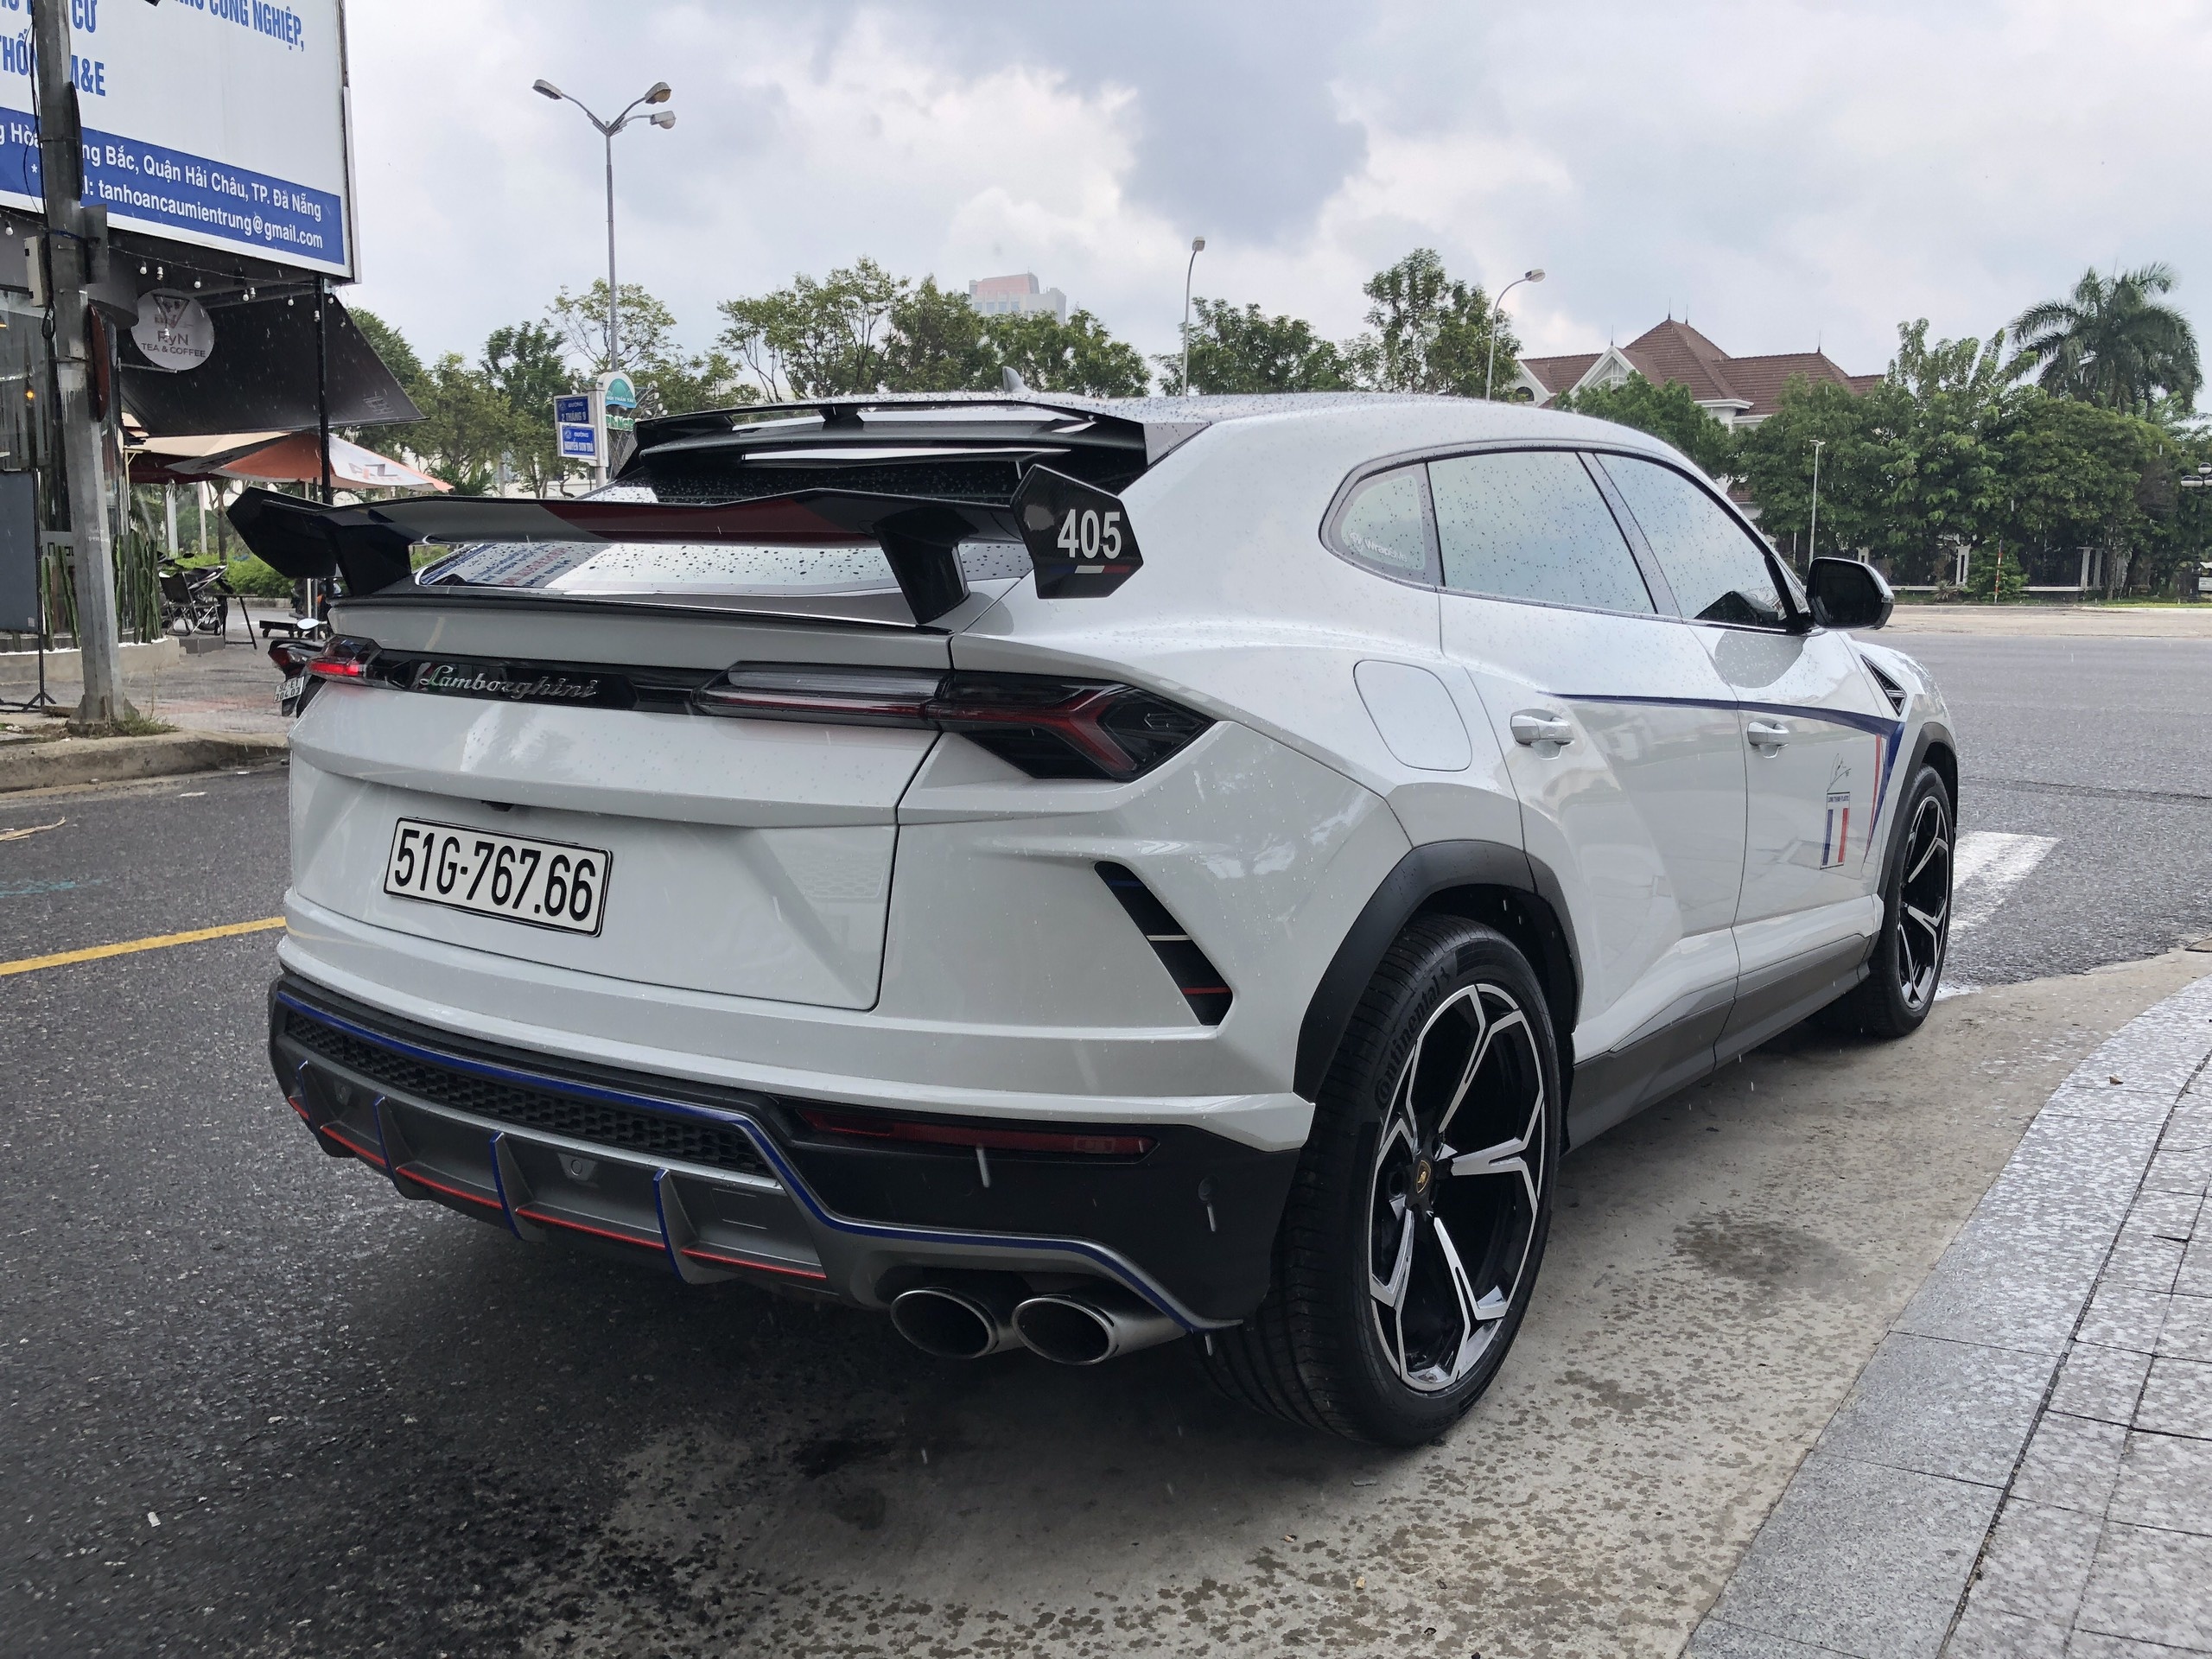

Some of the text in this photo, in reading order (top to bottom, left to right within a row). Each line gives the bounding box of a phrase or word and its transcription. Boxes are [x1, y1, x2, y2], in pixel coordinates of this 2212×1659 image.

[252, 0, 304, 52] NGHIỆP,
[99, 179, 323, 249] tanhoancaumientrung@gmail.com
[105, 145, 139, 175] Bắc,
[143, 156, 181, 183] Quận
[185, 165, 207, 188] Hải
[212, 173, 249, 201] Châu,
[251, 183, 270, 205] TP.
[273, 189, 289, 209] Đà
[292, 193, 321, 222] Nẵng
[141, 342, 207, 358] TEA & COFFEE
[1057, 509, 1122, 560] 405
[420, 664, 598, 700] Lamborghini
[395, 829, 596, 922] 51G-767.66
[1375, 975, 1441, 1110] Continental
